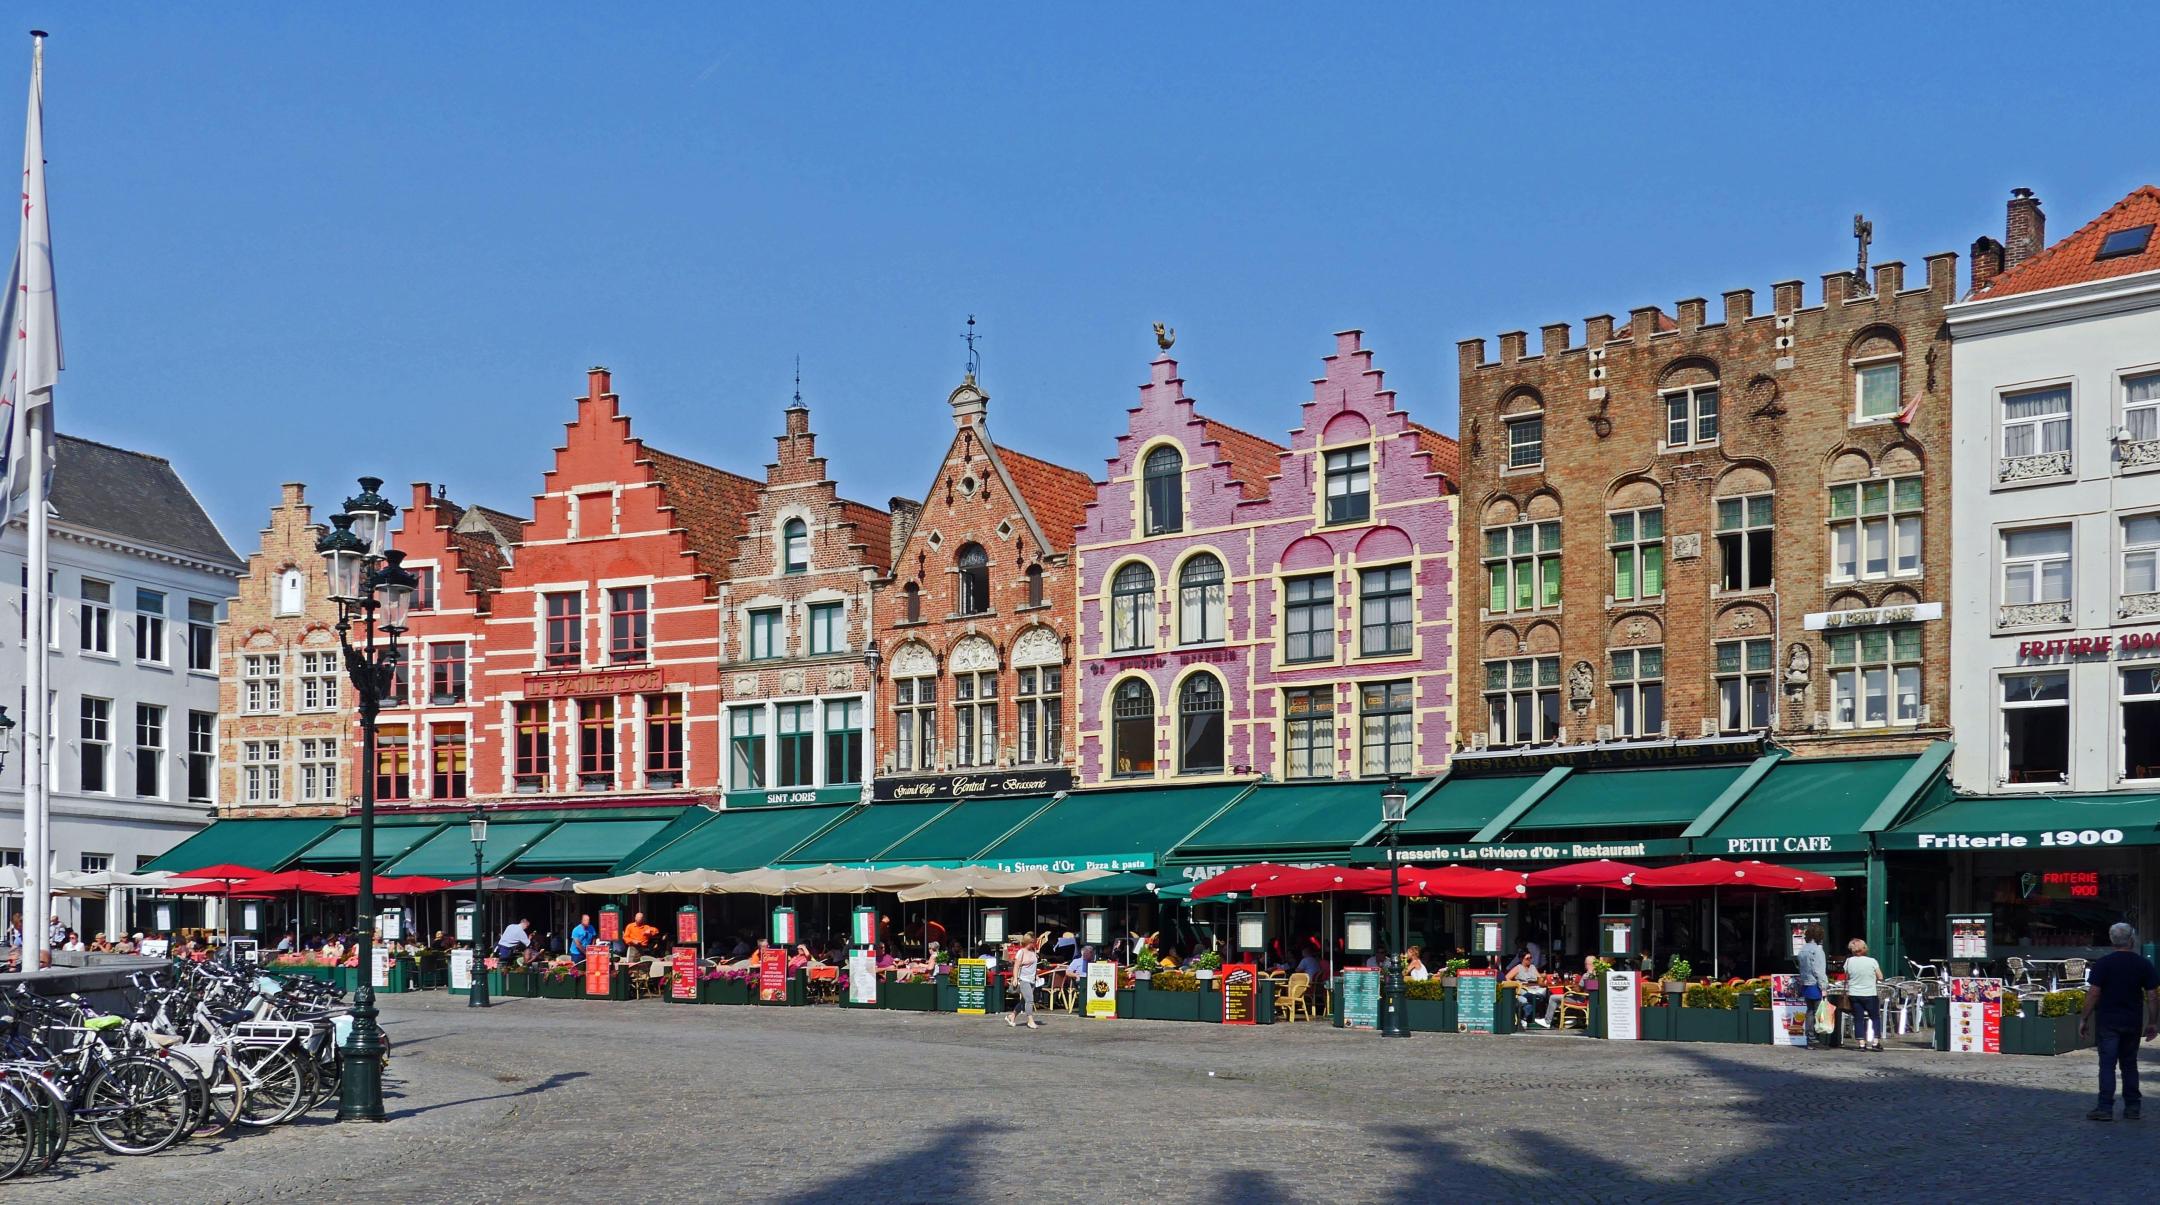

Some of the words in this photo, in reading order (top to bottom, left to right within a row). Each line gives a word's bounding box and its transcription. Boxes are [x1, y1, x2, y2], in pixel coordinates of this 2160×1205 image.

[1827, 613, 1841, 626] AU
[1845, 610, 1879, 625] PETIT
[2019, 636, 2113, 658] FRITERIE
[530, 680, 551, 696] LE
[554, 676, 615, 695] PANIER
[620, 672, 659, 690] D'OR
[1457, 753, 1577, 771] RESTAURANT
[952, 777, 987, 796] Central
[1002, 777, 1047, 790] Brasserie
[767, 793, 788, 803] SINT
[790, 791, 816, 802] JORIS
[1728, 838, 1779, 853] PETIT
[1783, 836, 1832, 852] CAFE
[1918, 833, 2028, 848] Friterie
[2040, 829, 2124, 846] 1900
[1460, 848, 1477, 859] La
[1530, 846, 1559, 858] d'Or
[1572, 842, 1645, 857] Restaurant
[1052, 860, 1075, 871] d'Or
[1086, 861, 1109, 870] Pizza
[1112, 860, 1119, 869] &
[1122, 860, 1145, 872] pasta
[2043, 872, 2097, 884] FRITERIE
[2072, 885, 2097, 896] 1900
